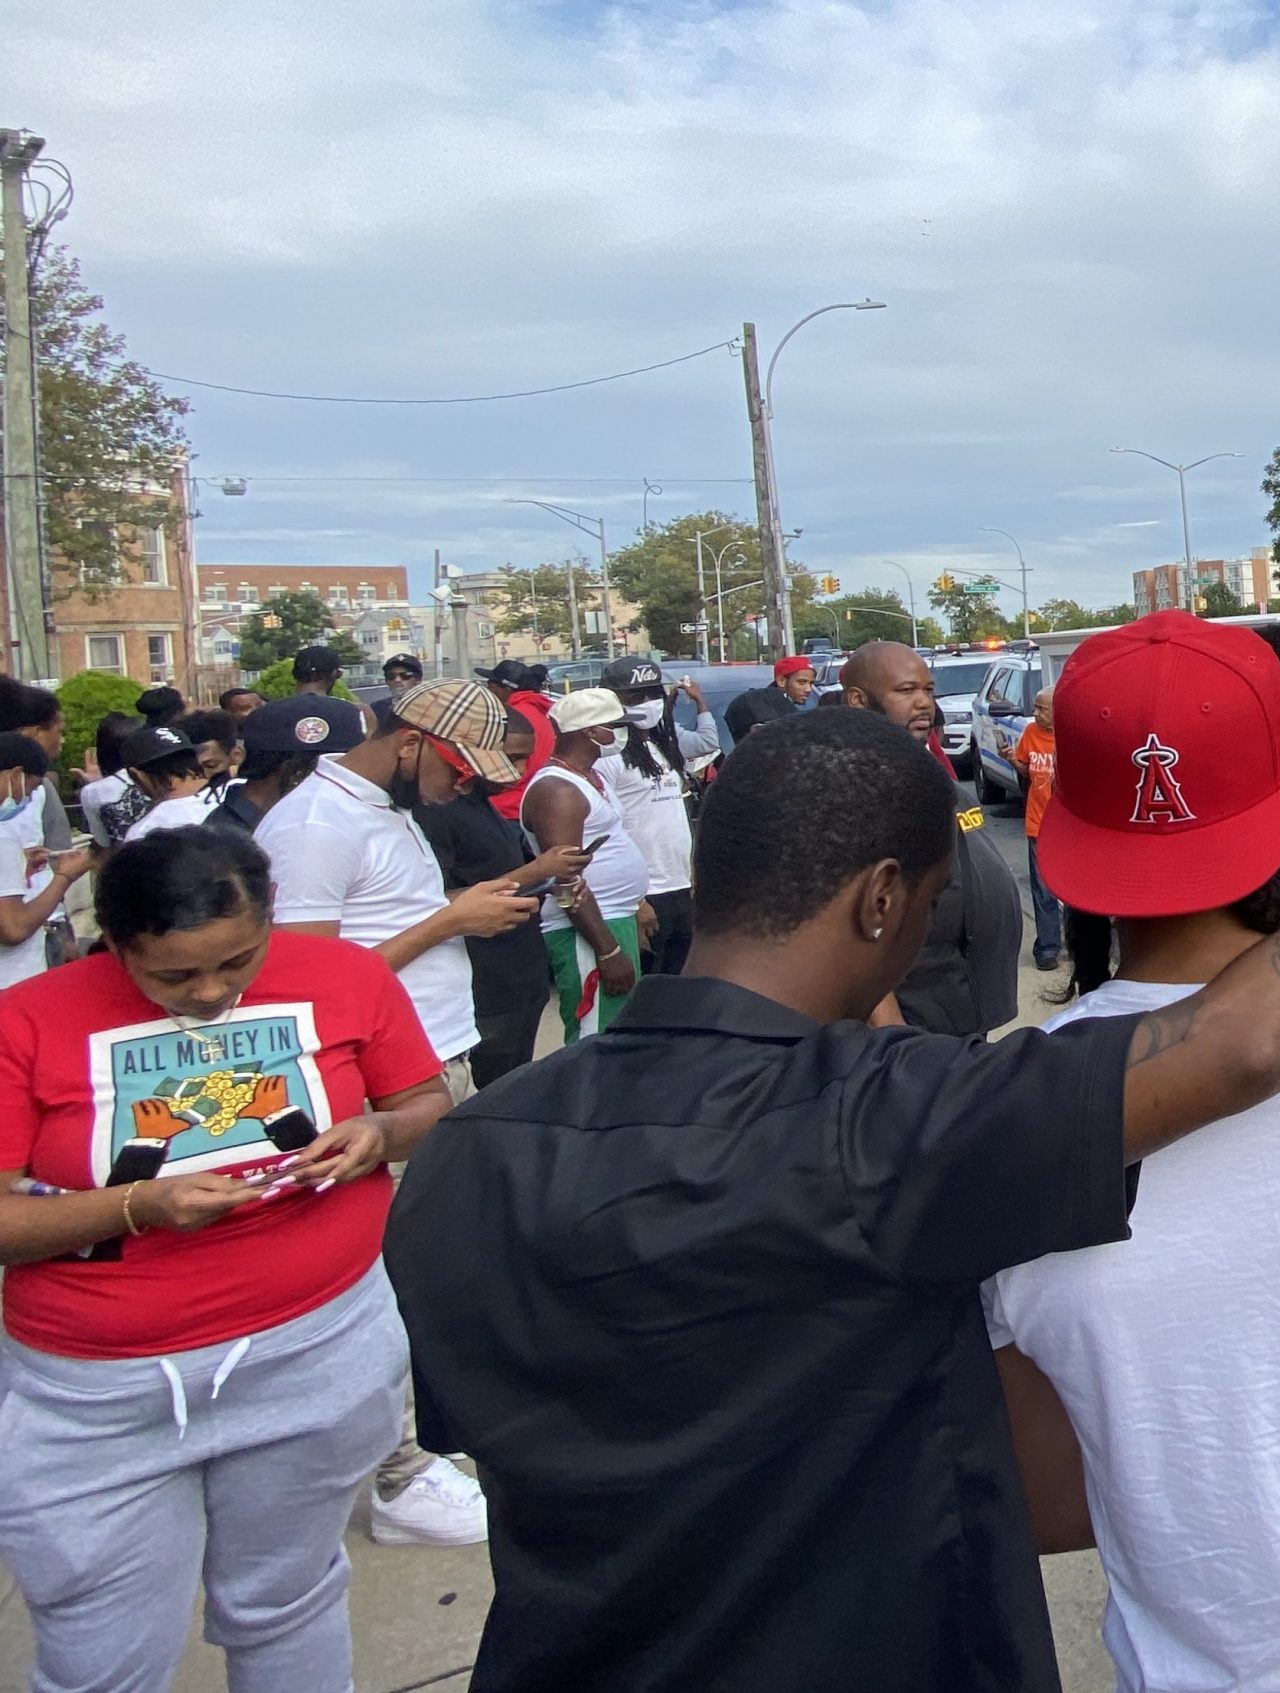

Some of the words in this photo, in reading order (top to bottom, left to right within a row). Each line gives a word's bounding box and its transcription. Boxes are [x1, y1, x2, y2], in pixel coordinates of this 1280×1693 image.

[630, 667, 658, 684] Nets
[1129, 733, 1197, 823] A
[123, 1045, 166, 1074] ALL
[269, 1025, 292, 1052] IN
